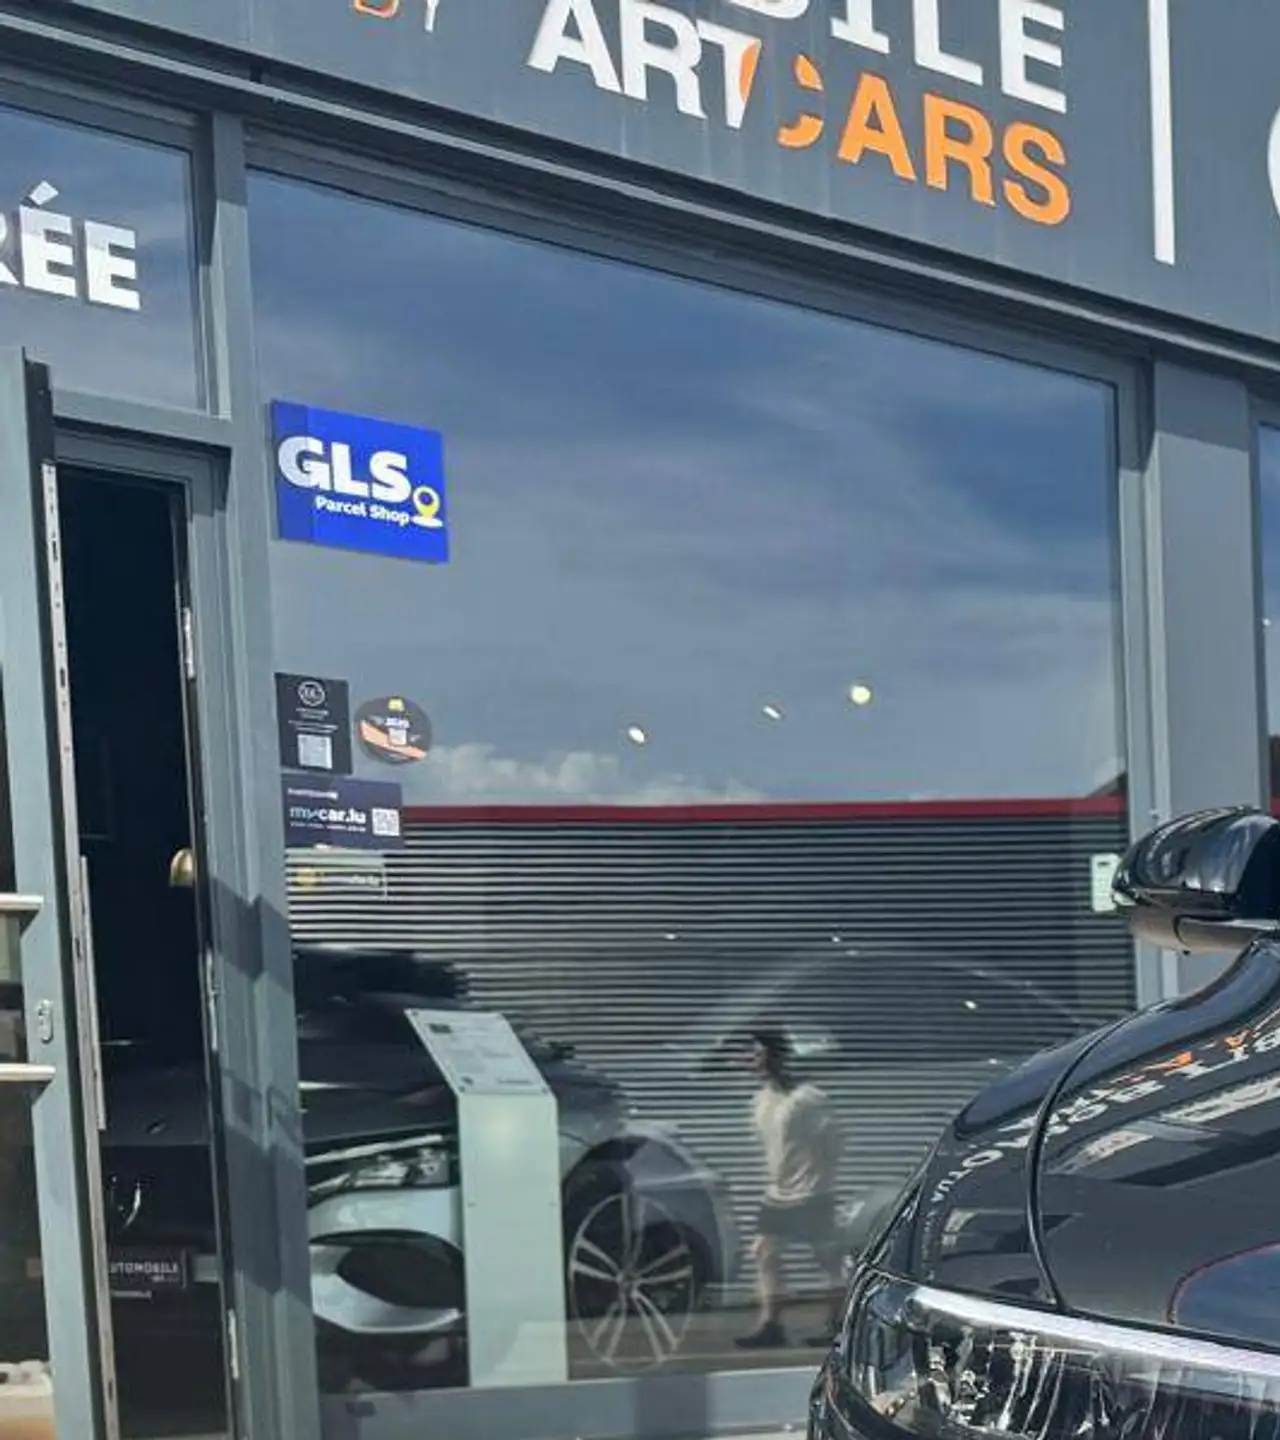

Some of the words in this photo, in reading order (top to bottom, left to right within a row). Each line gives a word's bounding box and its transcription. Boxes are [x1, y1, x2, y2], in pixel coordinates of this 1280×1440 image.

[278, 434, 412, 503] GLS
[315, 494, 367, 518] Parcel
[370, 505, 410, 527] Shop
